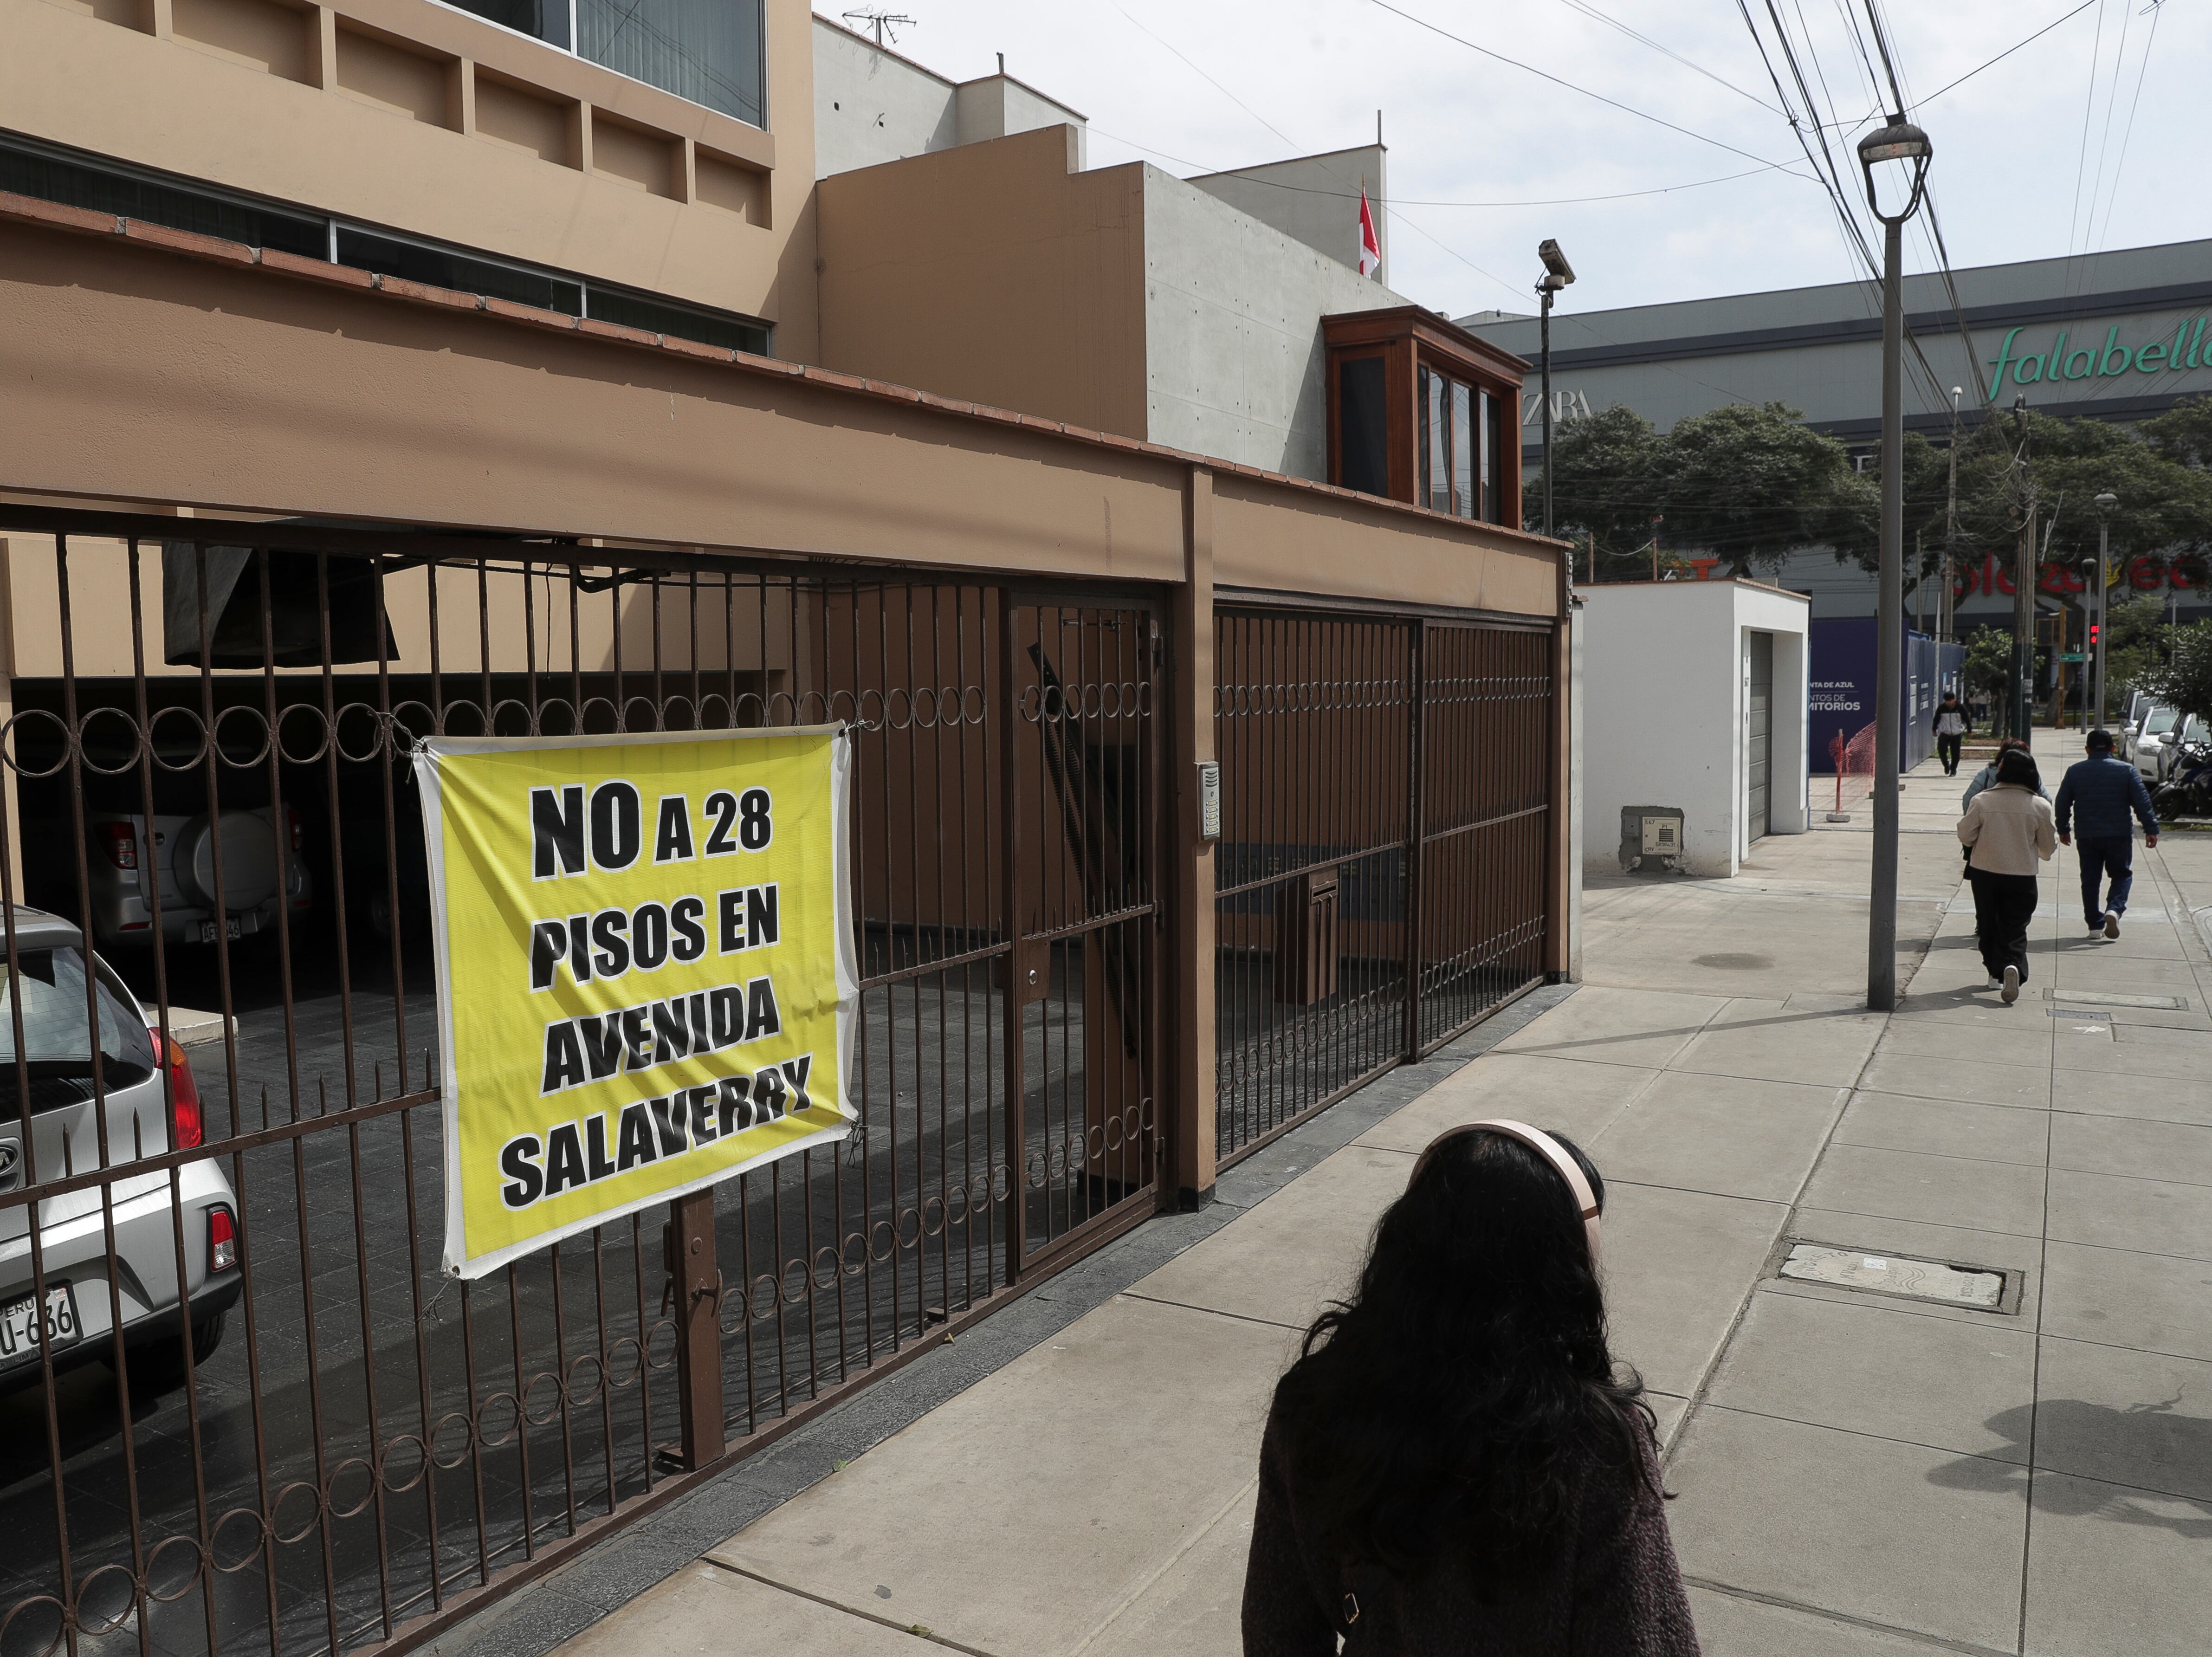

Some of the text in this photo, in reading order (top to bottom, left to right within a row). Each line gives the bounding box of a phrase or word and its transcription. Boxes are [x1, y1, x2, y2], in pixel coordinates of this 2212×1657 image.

[1523, 388, 1592, 426] ZARA
[1980, 317, 2212, 407] falabell
[529, 779, 774, 881] NO A 28
[529, 883, 781, 993] PISOS EN
[539, 975, 782, 1097] AVENIDA
[499, 1051, 814, 1210] SALAVERRY
